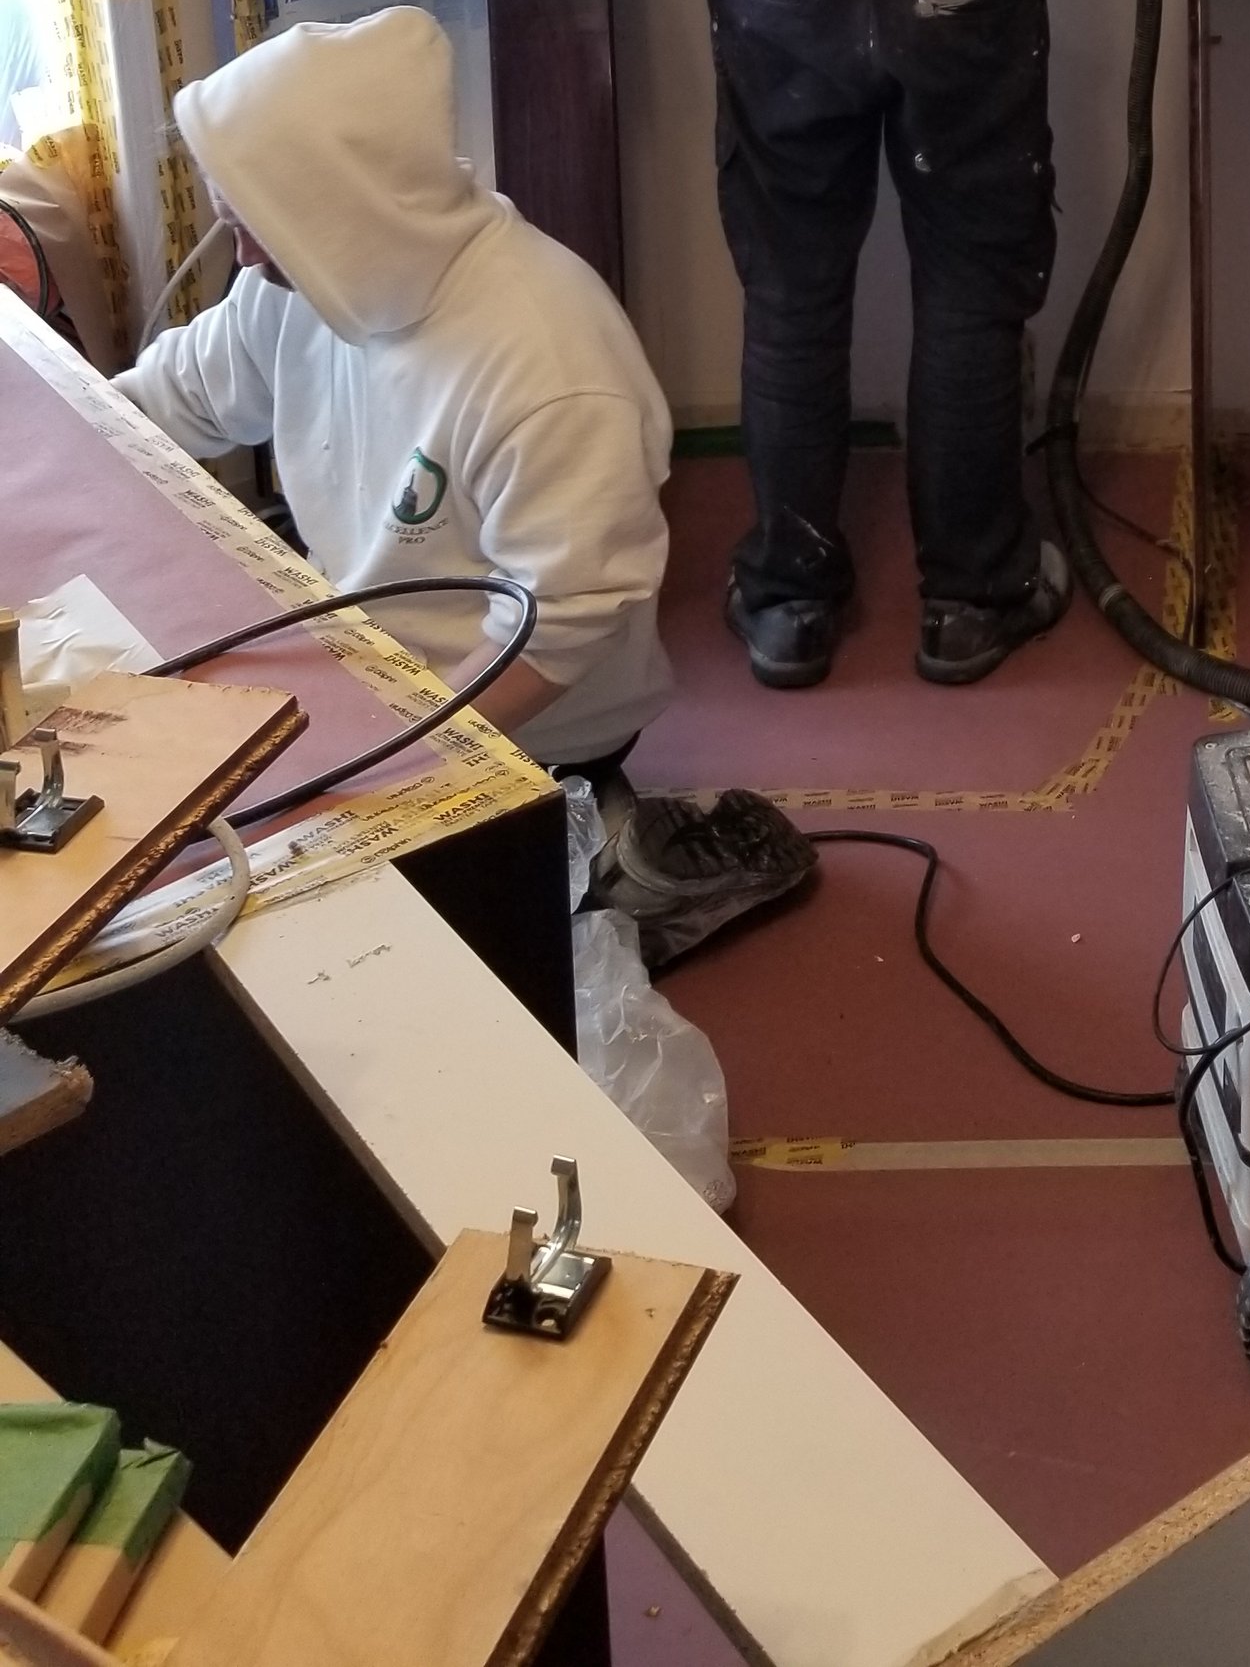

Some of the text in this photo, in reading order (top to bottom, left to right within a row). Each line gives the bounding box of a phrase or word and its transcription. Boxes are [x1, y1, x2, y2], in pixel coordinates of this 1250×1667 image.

[184, 489, 217, 508] WASHI
[254, 537, 289, 557] WASHI
[284, 566, 320, 585] WASHI
[384, 654, 422, 676] WASHI
[443, 727, 485, 752] WASHI
[433, 792, 492, 822] WASHI
[297, 809, 356, 843] WASHI
[155, 906, 220, 938] WASHI
